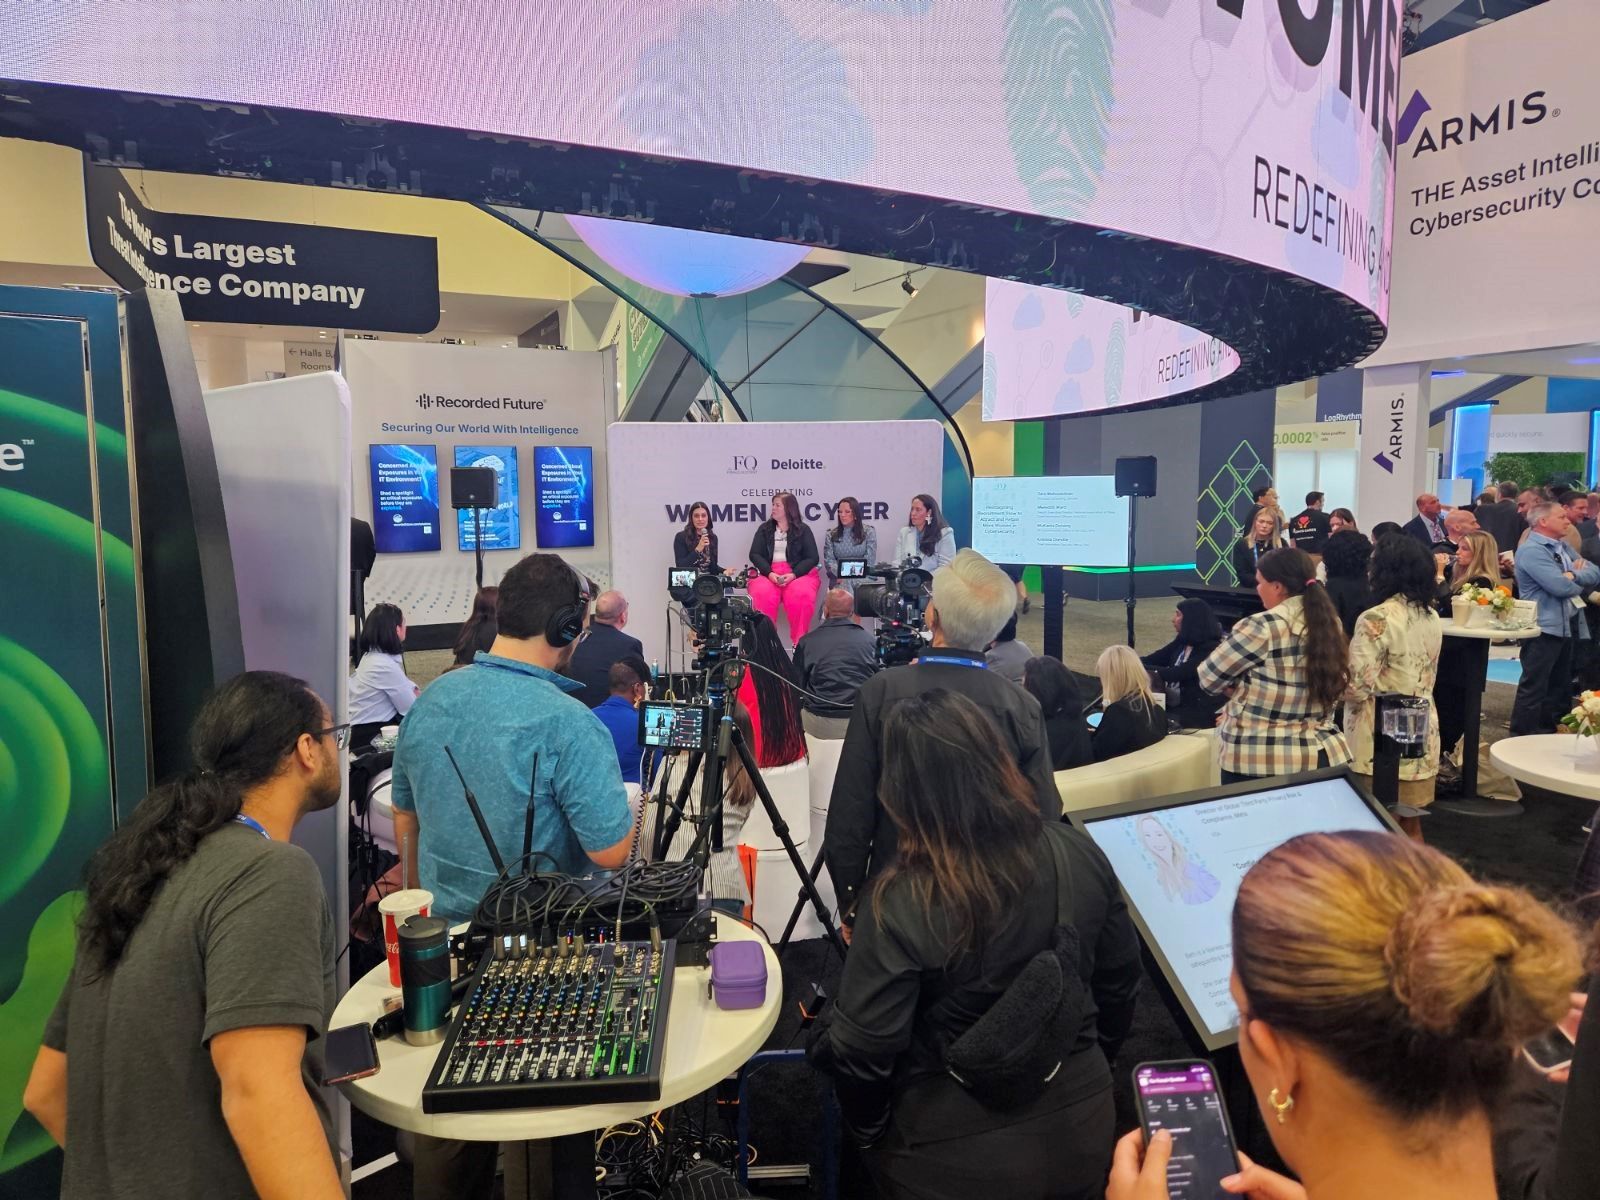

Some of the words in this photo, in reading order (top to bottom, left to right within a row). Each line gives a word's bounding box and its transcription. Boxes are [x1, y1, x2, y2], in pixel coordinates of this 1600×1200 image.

[1411, 180, 1455, 207] THE
[1460, 163, 1526, 195] Asset
[1532, 141, 1600, 178] Intelli
[1253, 154, 1376, 276] REDEFINING
[1409, 186, 1567, 237] Cybersecurity
[119, 191, 132, 230] The
[131, 208, 168, 256] World's
[174, 234, 297, 268] Largest
[218, 273, 366, 310] Company
[300, 348, 322, 358] Halls
[301, 361, 332, 370] Rooms
[1157, 337, 1217, 385] REDEFINING
[436, 395, 500, 409] Recorded
[381, 422, 433, 435] Securing
[435, 423, 455, 433] Our
[458, 423, 490, 434] World
[493, 424, 518, 434] With
[519, 425, 579, 436] Intelligence
[732, 455, 759, 471] FQ
[665, 504, 767, 523] WMEN
[804, 502, 890, 522] CYER
